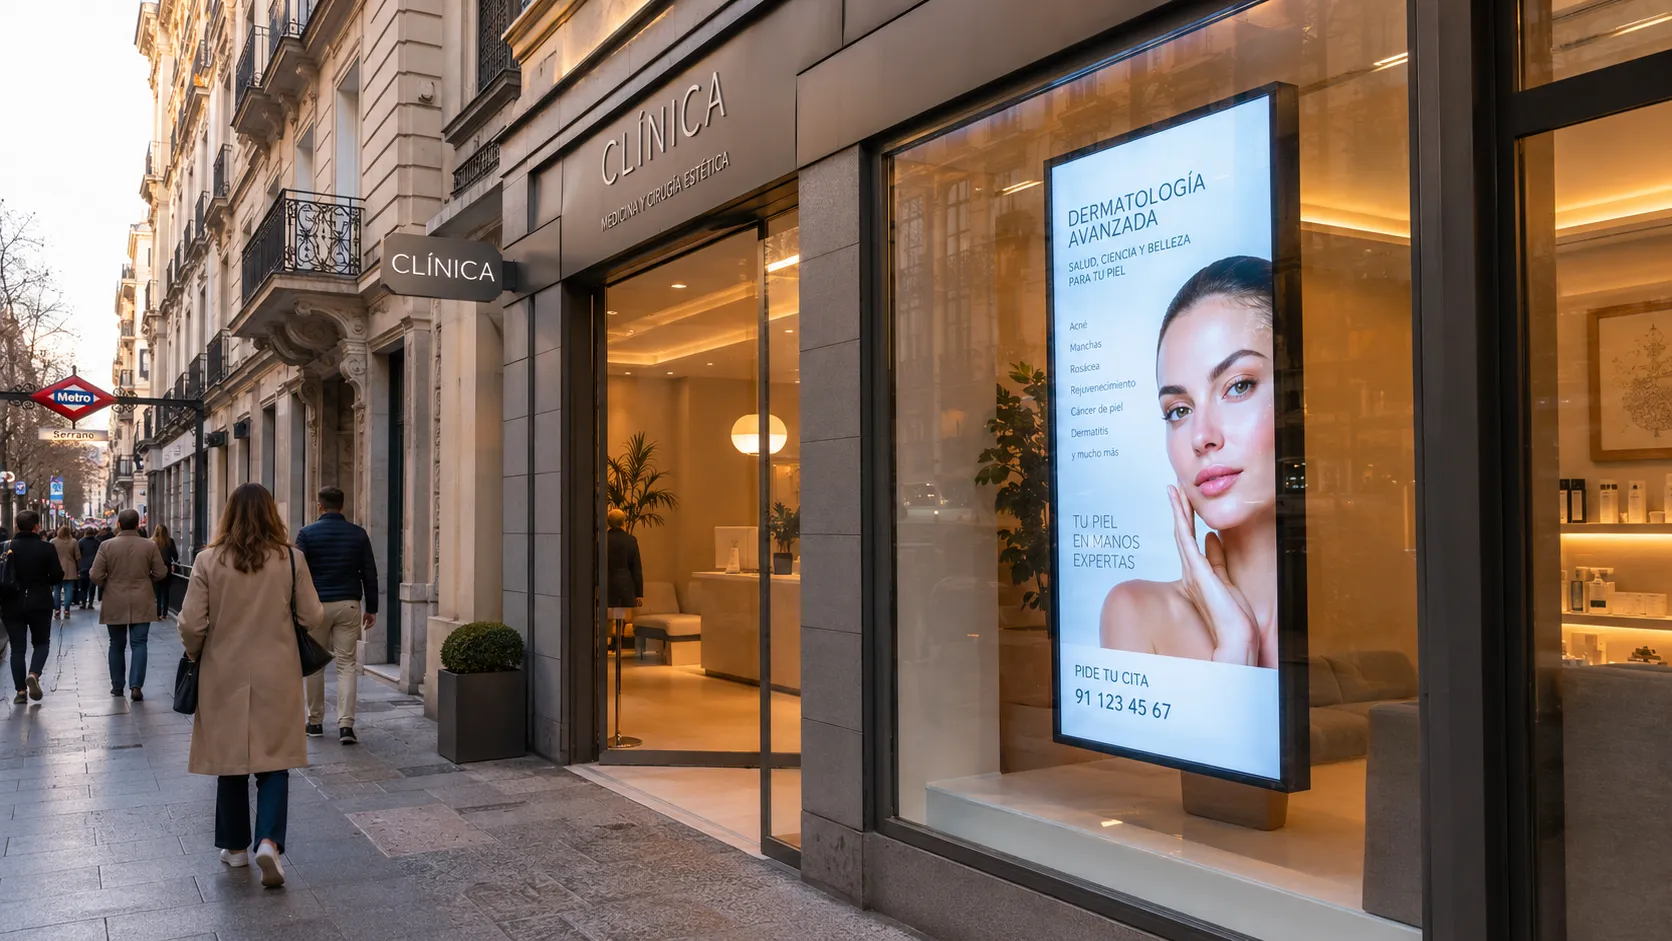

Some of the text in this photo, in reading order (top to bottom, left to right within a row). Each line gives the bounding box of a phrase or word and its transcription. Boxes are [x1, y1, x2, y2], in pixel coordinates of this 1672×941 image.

[602, 71, 727, 185] CLÍNICA
[601, 151, 730, 231] MEDICINA Y CIRUGÍA ESTÉTICA
[1068, 171, 1206, 227] DERMATOLOGÍA
[1068, 209, 1158, 248] AVANZADA
[1068, 234, 1191, 273] SALUD, CIENCIA Y BELLEZA
[391, 252, 495, 282] CLÍNICA
[1068, 265, 1126, 287] PARA TU PIEL
[1069, 320, 1088, 331] Acné
[1069, 340, 1102, 352] Manchas
[1070, 362, 1100, 373] Rosácea
[1070, 379, 1136, 397] Rejuvenecimiento
[57, 392, 91, 403] Metro
[1070, 401, 1123, 416] Cáncer de piel
[53, 430, 95, 439] Serrano
[1071, 426, 1108, 438] Dermatitis
[1071, 447, 1119, 461] y mucho más
[1073, 514, 1117, 529] TU PIEL
[1073, 534, 1140, 550] EN MANOS
[1073, 553, 1136, 570] EXPERTAS
[1075, 664, 1149, 688] PIDE TU CITA
[1075, 688, 1171, 720] 91 123 45 67
